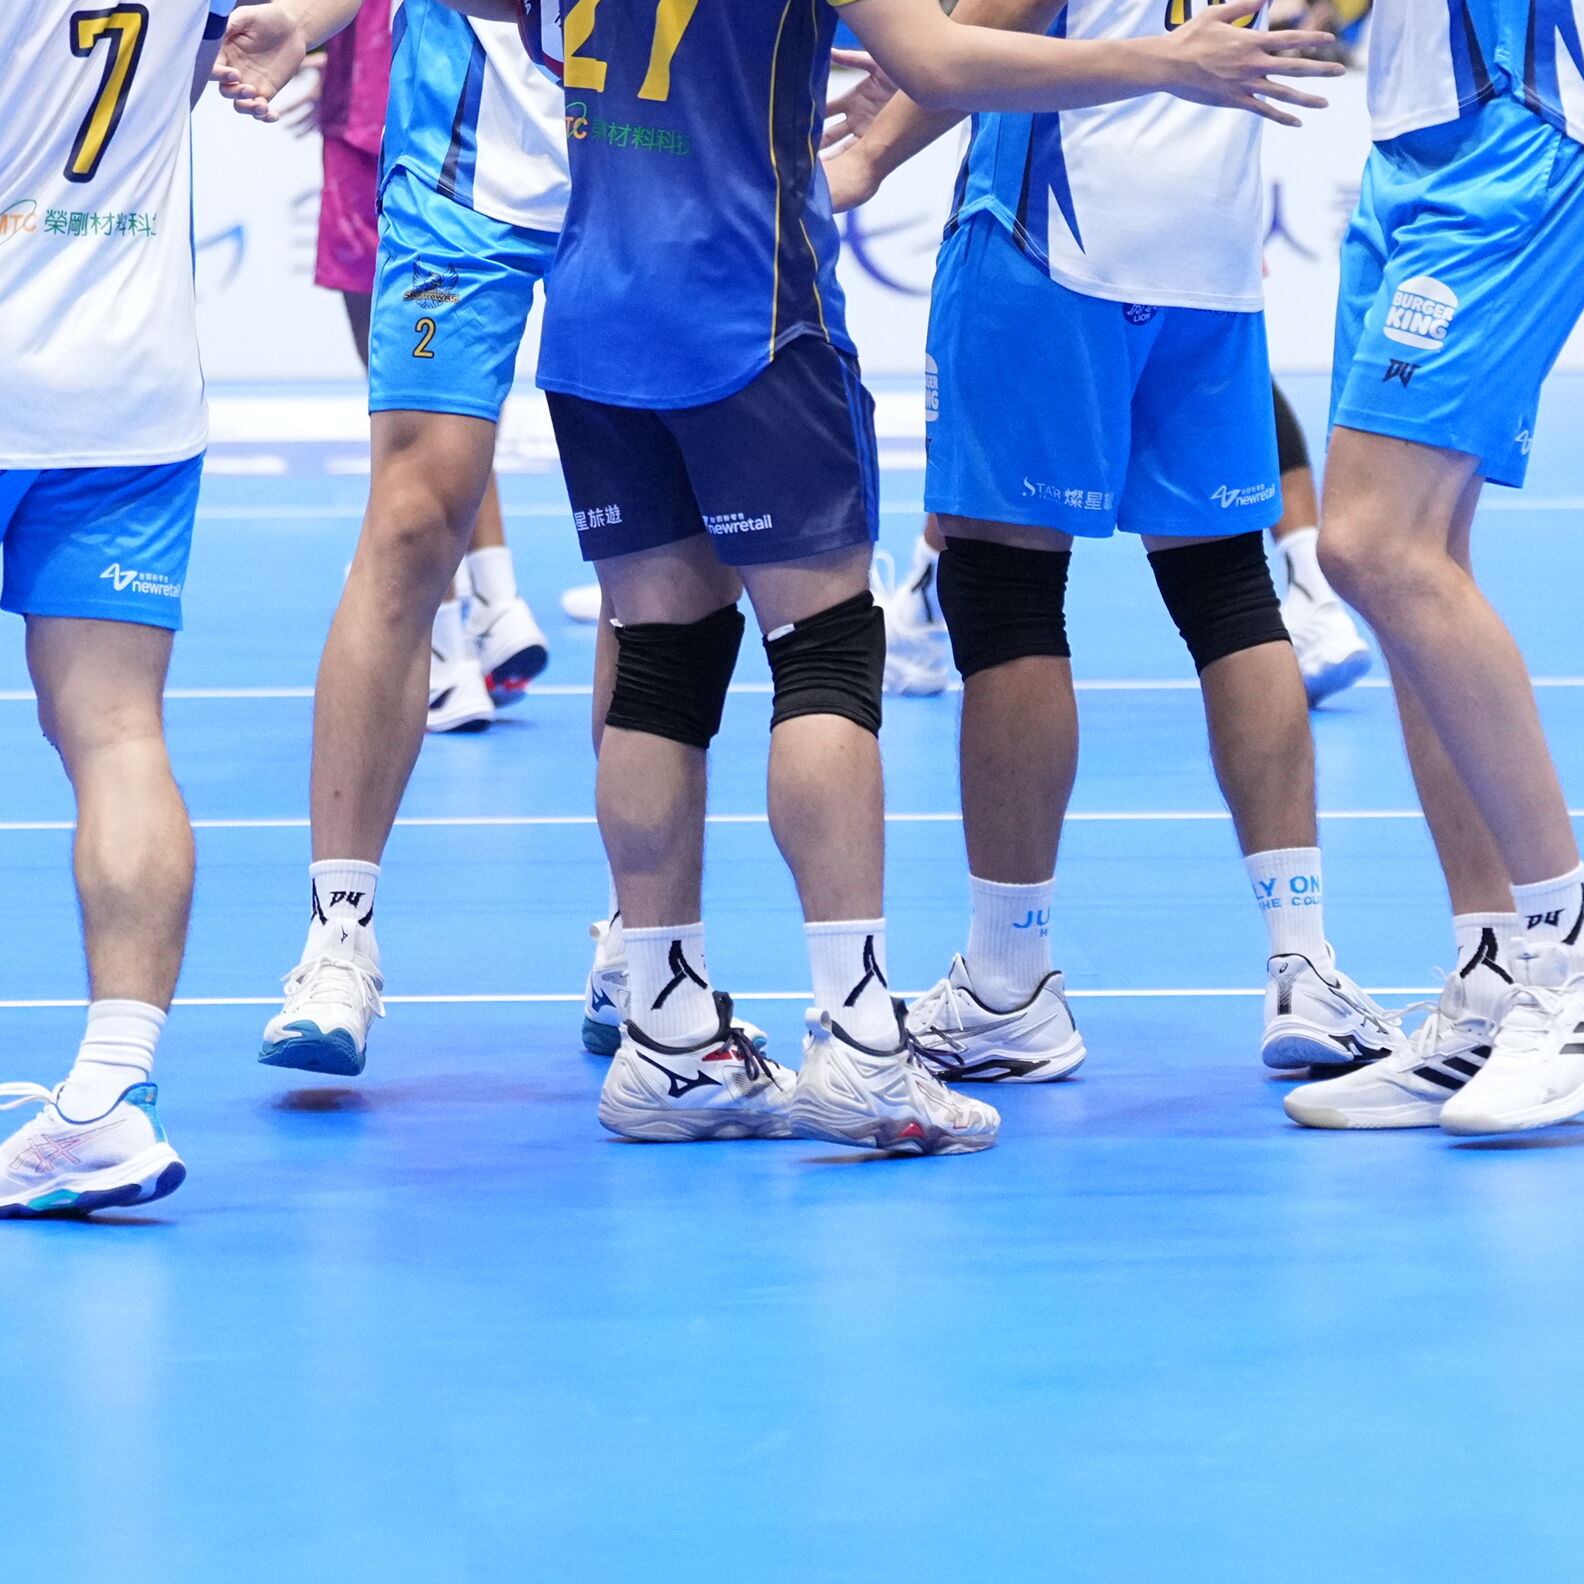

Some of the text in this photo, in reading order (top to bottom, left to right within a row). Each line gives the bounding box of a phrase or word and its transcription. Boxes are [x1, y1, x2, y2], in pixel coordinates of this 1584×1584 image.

[63, 3, 149, 184] 7
[1393, 292, 1455, 321] BURGER
[412, 316, 437, 359] 2
[1384, 307, 1450, 341] KING
[708, 514, 773, 535] newretail
